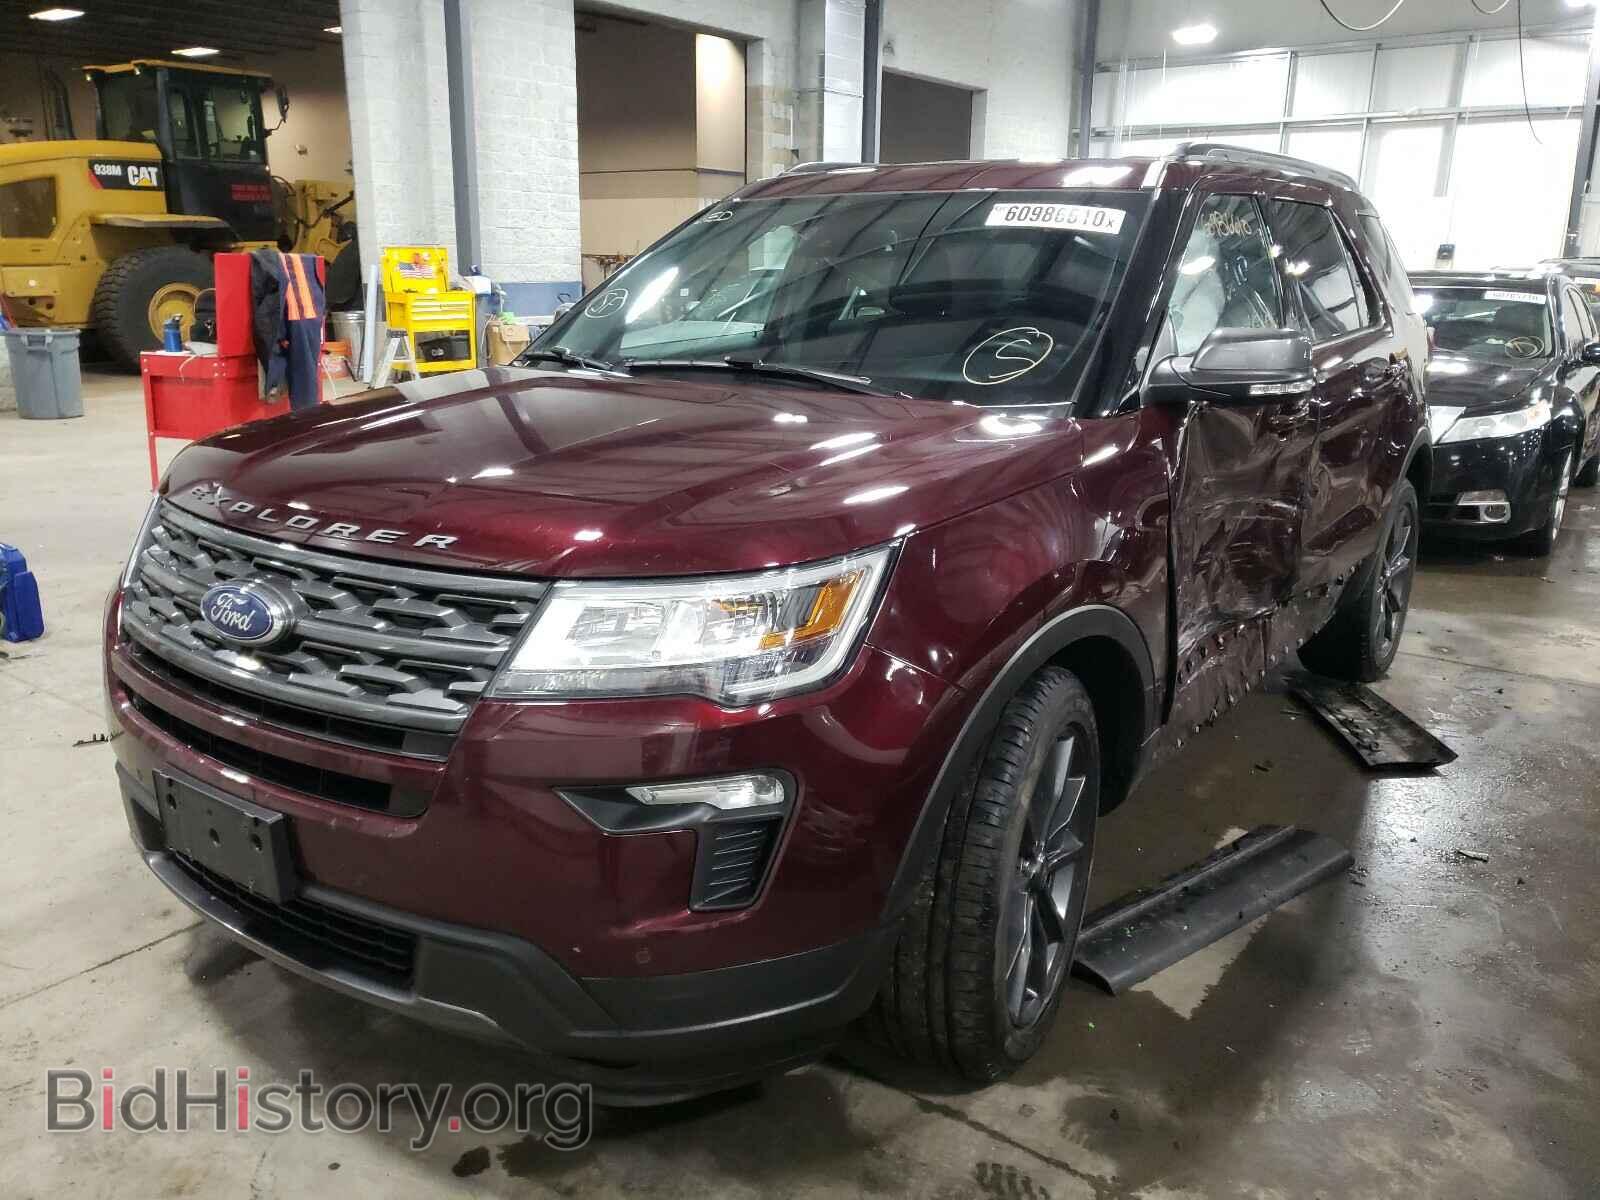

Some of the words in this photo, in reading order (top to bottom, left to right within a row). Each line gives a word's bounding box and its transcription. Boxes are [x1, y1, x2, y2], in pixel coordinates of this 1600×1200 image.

[94, 164, 122, 176] 938M
[127, 165, 158, 187] CAT
[191, 482, 459, 549] EXPLORER
[210, 592, 257, 632] Ford
